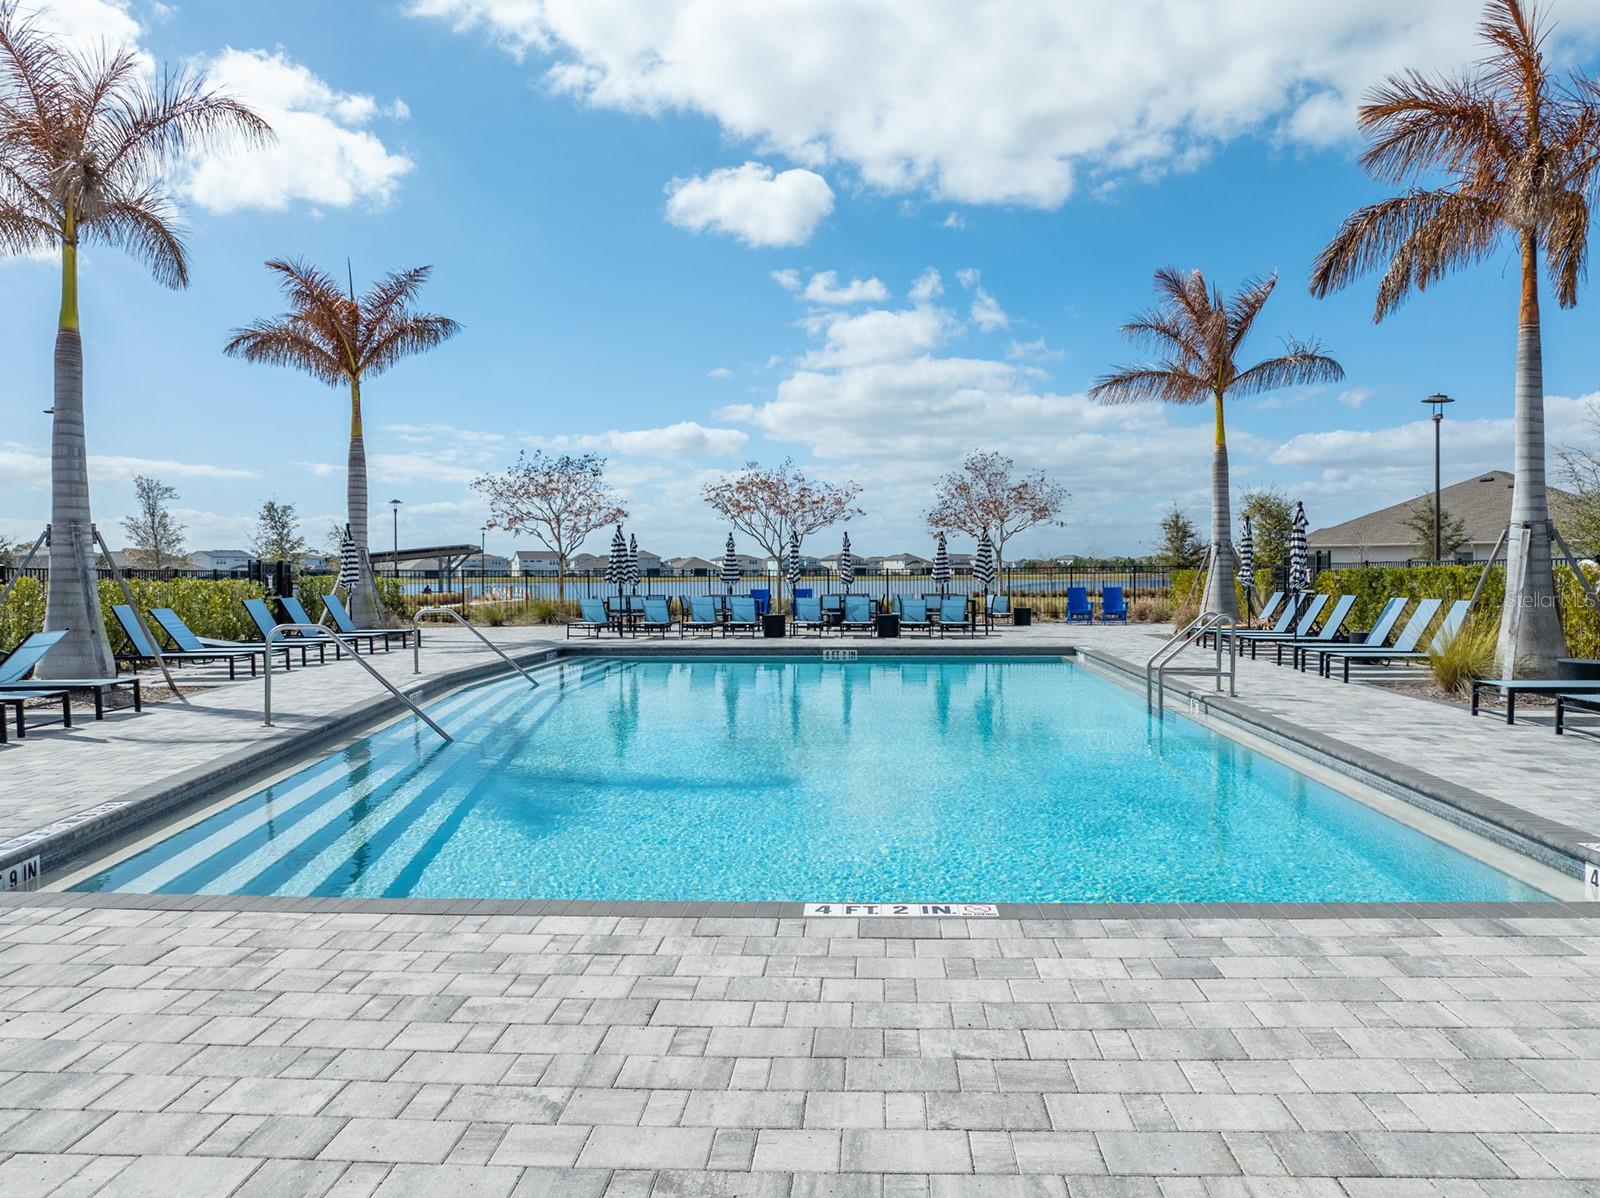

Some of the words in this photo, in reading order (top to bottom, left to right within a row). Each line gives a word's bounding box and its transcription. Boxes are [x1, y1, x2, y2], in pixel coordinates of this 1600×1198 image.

[10, 870, 18, 887] 9
[24, 860, 37, 881] IN
[1591, 869, 1600, 887] 4
[815, 905, 831, 914] 4
[893, 905, 909, 914] 2
